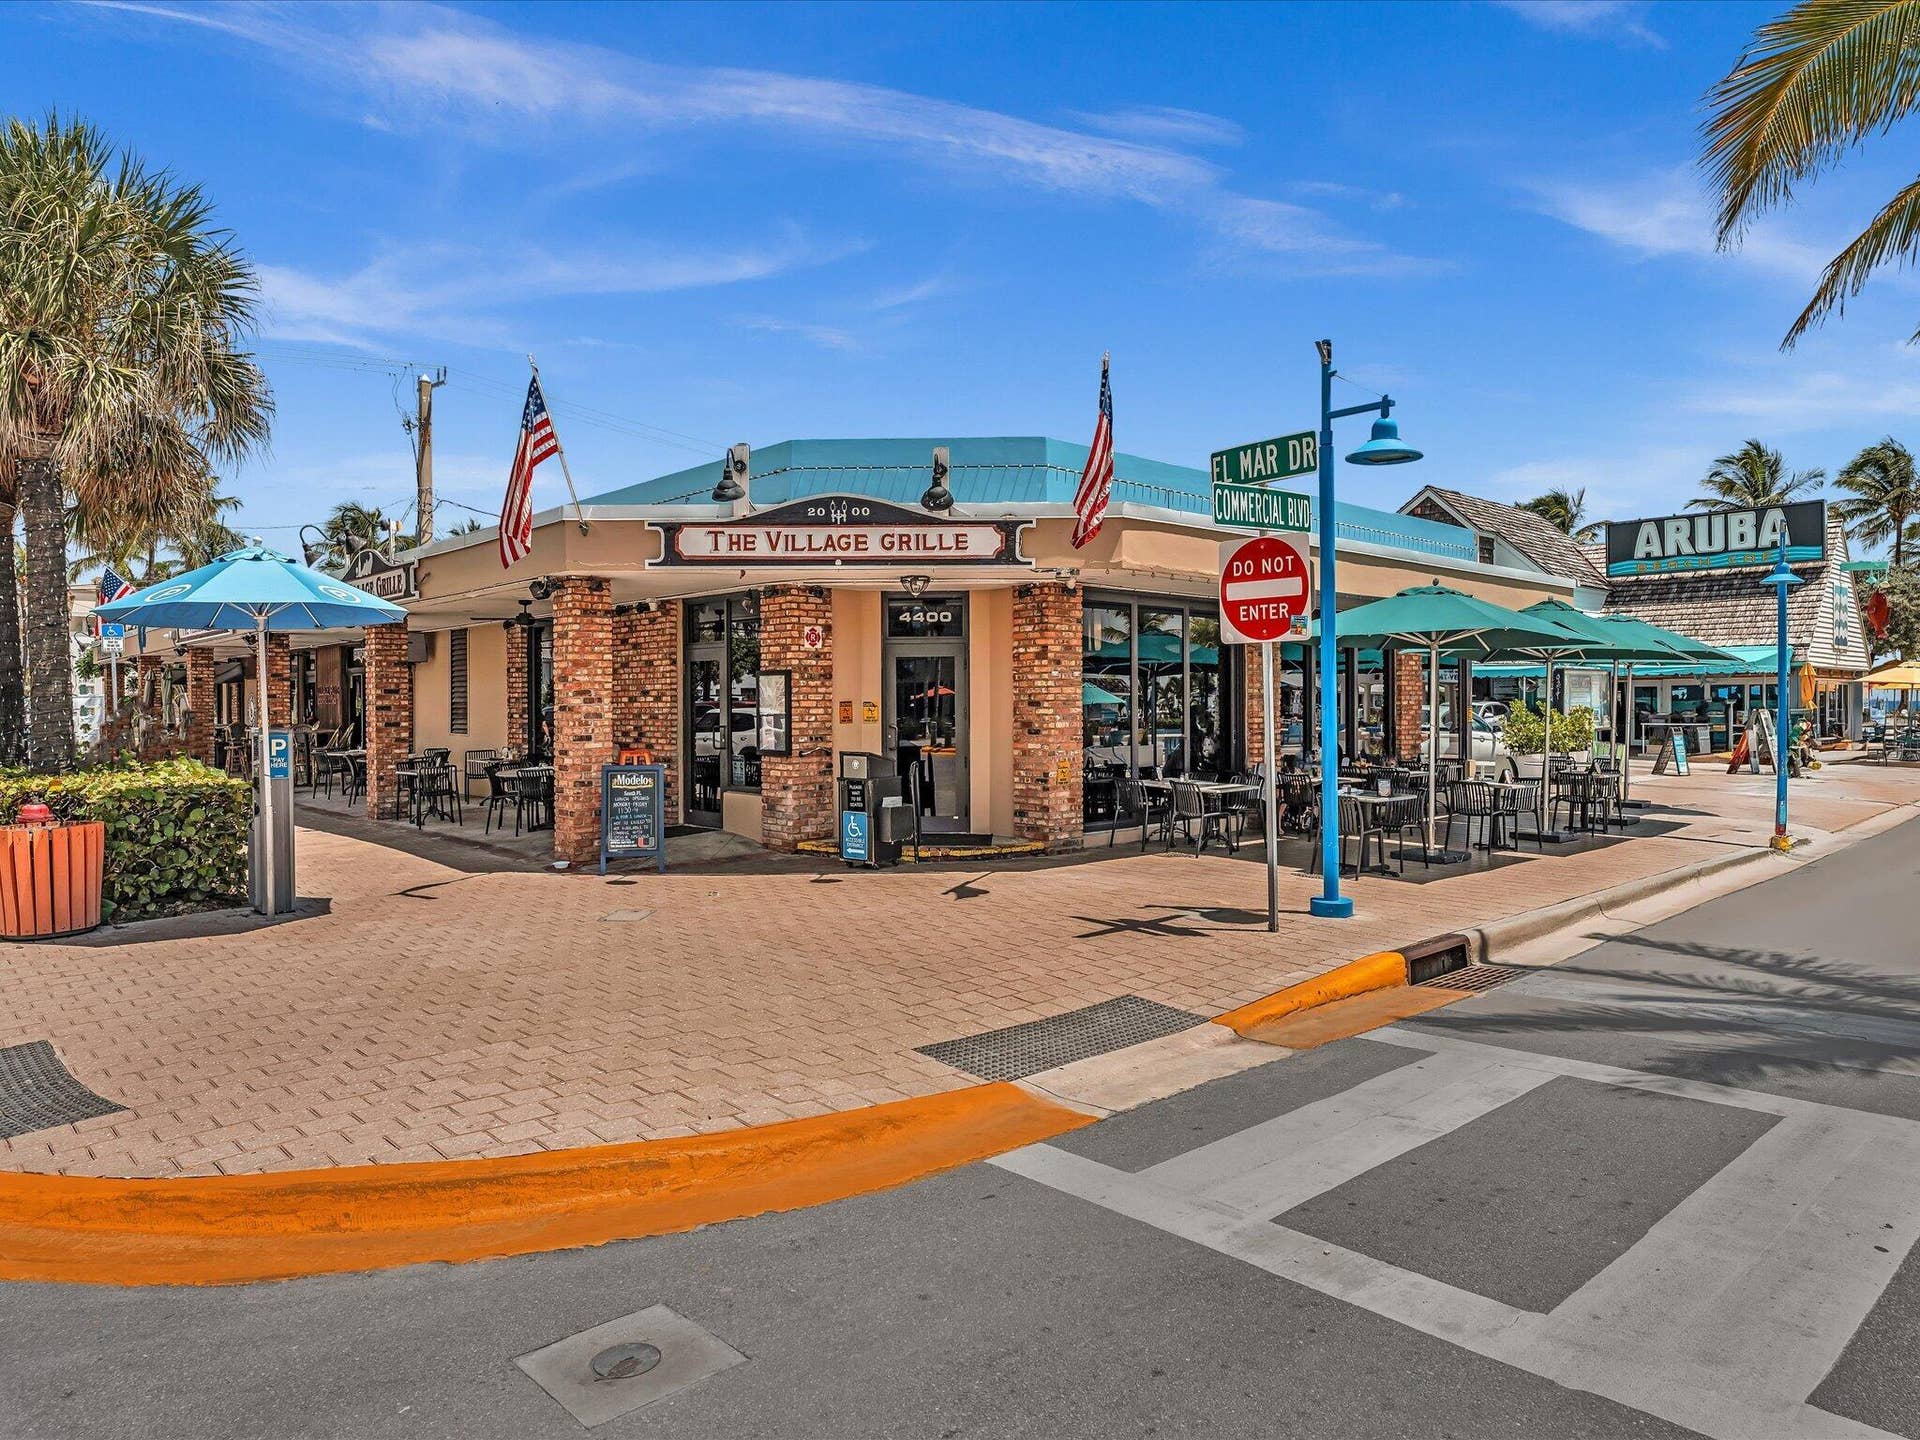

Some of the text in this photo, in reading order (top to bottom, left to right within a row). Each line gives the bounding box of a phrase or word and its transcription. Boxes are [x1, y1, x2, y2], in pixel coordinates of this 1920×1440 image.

[1212, 437, 1315, 483] EL MAR DR
[807, 506, 870, 517] 20 00
[1215, 488, 1310, 528] COMMERCIAL BLVD
[706, 530, 969, 552] THE VILLAGE GRILLE
[1633, 507, 1792, 560] ARUBA
[1232, 555, 1295, 576] DO NOT
[375, 574, 403, 597] GRILLE
[898, 611, 952, 623] 4400
[1239, 602, 1289, 621] ENTER
[271, 738, 287, 756] P
[617, 775, 648, 786] Modelo
